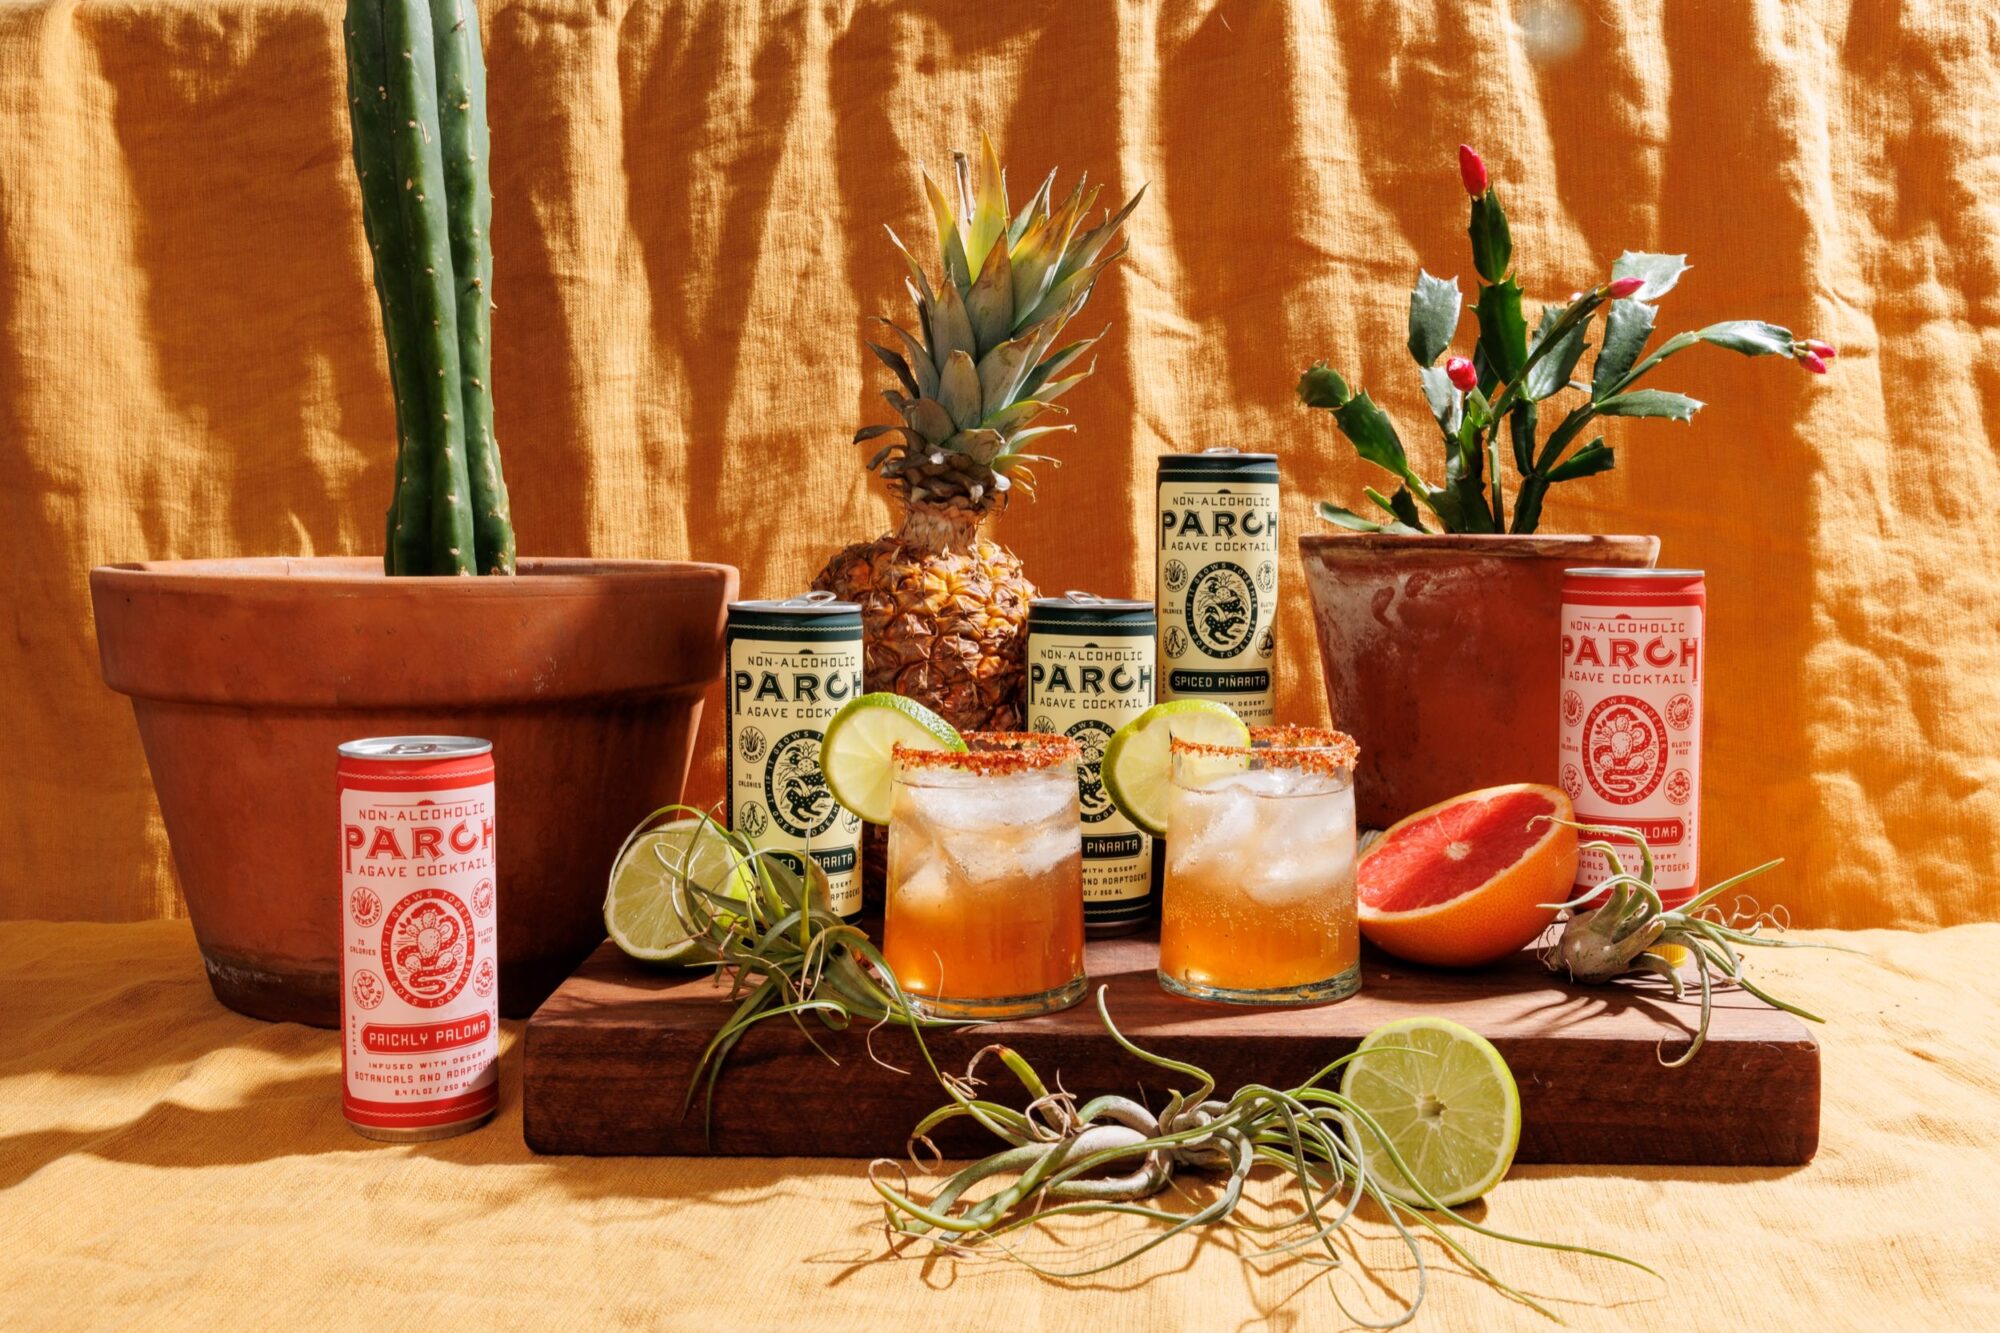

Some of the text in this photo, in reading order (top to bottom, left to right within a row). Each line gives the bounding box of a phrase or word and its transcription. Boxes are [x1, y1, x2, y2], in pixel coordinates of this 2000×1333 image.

[1172, 496, 1270, 506] NON-ALCOHOLIC
[1161, 508, 1278, 553] PARCH
[1171, 542, 1270, 552] AGAVE COCKTAIL
[1195, 563, 1226, 584] GROWS
[1570, 621, 1685, 633] NON-ALCOHOLIC
[748, 656, 855, 668] NON-ALCOHOLIC
[1040, 650, 1142, 661] NON-ALCOHOLIC
[1561, 634, 1698, 682] PARCH
[1030, 662, 1153, 706] PARCH
[1175, 676, 1212, 687] SPICED
[1218, 675, 1266, 688] PIÑARITA
[1568, 671, 1686, 684] AGAVE COCKTAIL
[735, 669, 862, 715] PARCH
[1040, 698, 1142, 709] AGAVE COCKTAIL
[1590, 698, 1626, 719] GROWS
[747, 707, 839, 718] AGAVE COCKT
[1066, 721, 1094, 737] ROWS
[774, 731, 809, 754] GROWS
[359, 803, 484, 821] NON-ALCOHOLIC
[773, 811, 796, 833] GOES
[344, 816, 494, 874] PARCH
[1087, 839, 1138, 853] PIÑARITA
[359, 858, 487, 877] AGAVE COCKTAIL
[1108, 865, 1137, 873] DESERT
[830, 880, 852, 889] ESERT
[1103, 872, 1146, 885] ADAPTOGENS
[392, 890, 433, 918] GROWS
[385, 924, 392, 934] IT
[350, 946, 376, 956] CALORIES
[383, 941, 389, 951] IF
[384, 955, 473, 1007] IT GOES TOGETHER
[369, 1020, 486, 1046] PRICKLY PALOMA
[420, 1060, 447, 1069] WITH
[453, 1049, 486, 1064] DESERT
[355, 1071, 414, 1083] BOTANICALS
[420, 1073, 440, 1083] AND
[444, 1083, 458, 1091] 250
